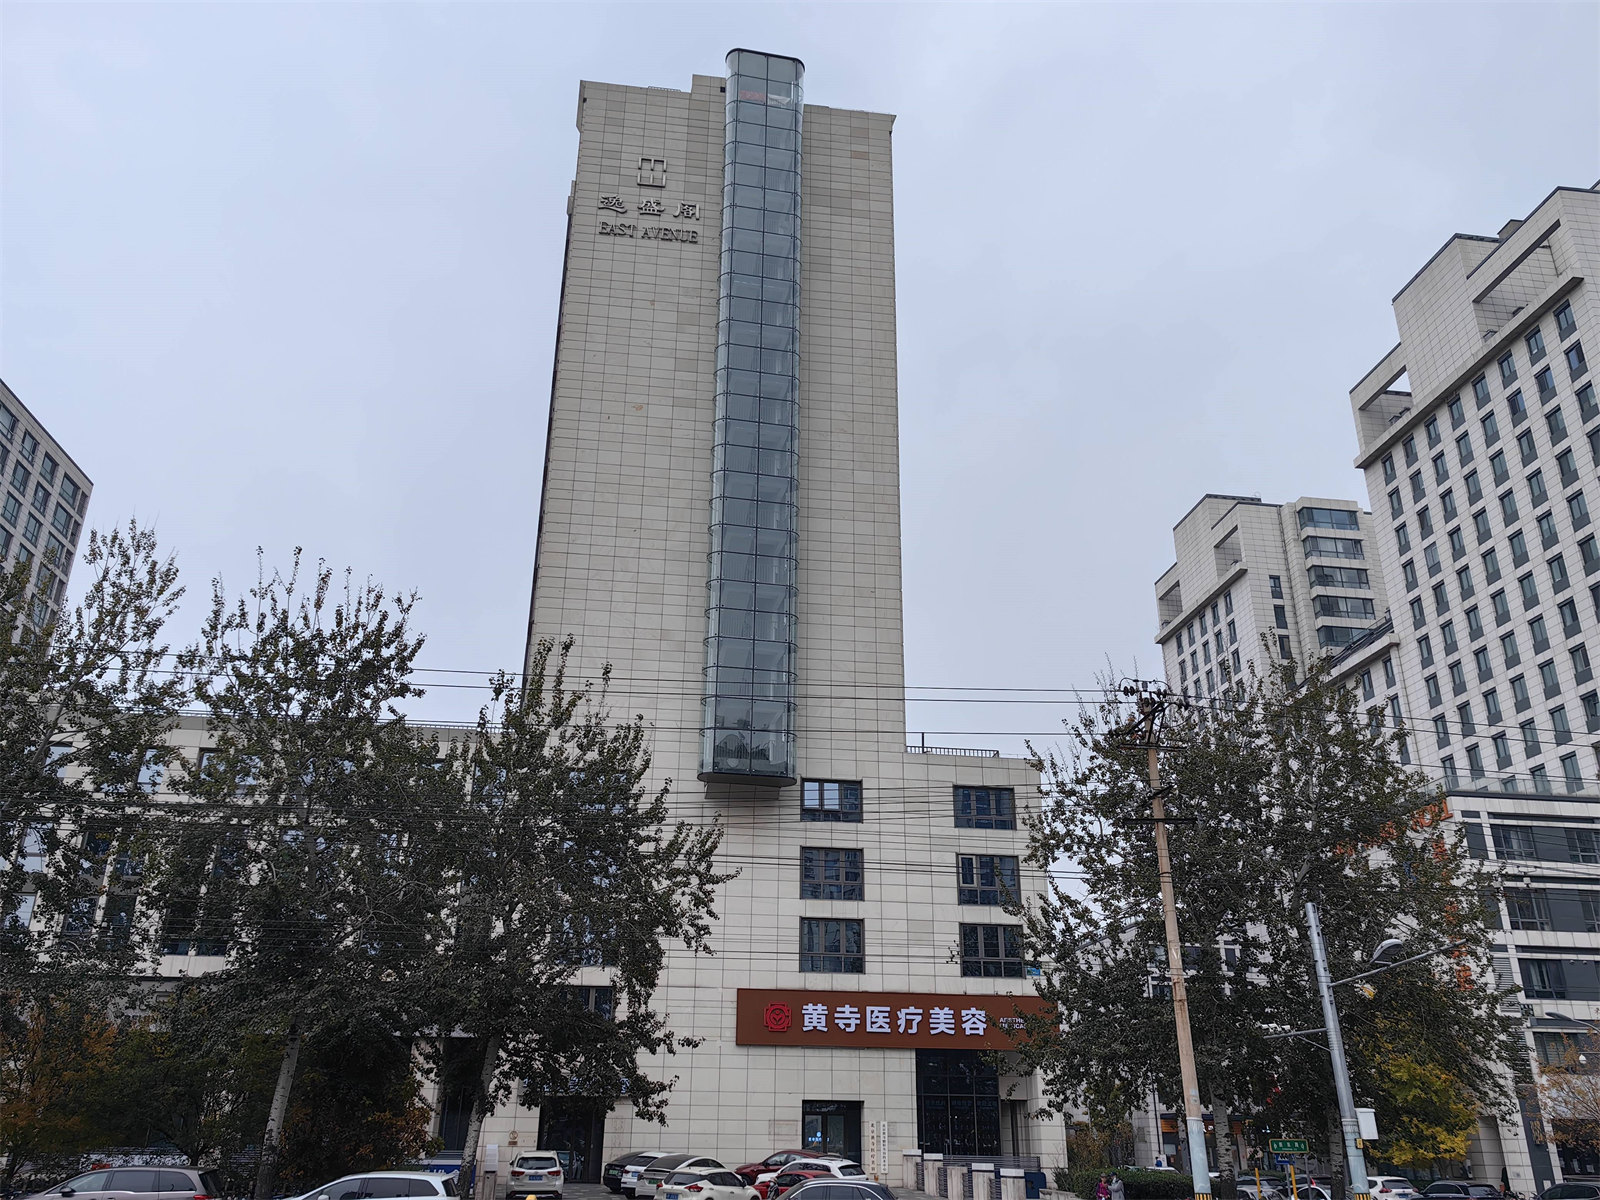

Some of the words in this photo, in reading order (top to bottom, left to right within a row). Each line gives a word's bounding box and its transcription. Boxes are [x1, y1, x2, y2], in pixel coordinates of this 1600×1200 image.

[599, 221, 637, 238] EAST
[641, 227, 699, 243] AVENUE
[801, 1003, 987, 1036] 黄寺医疗美容
